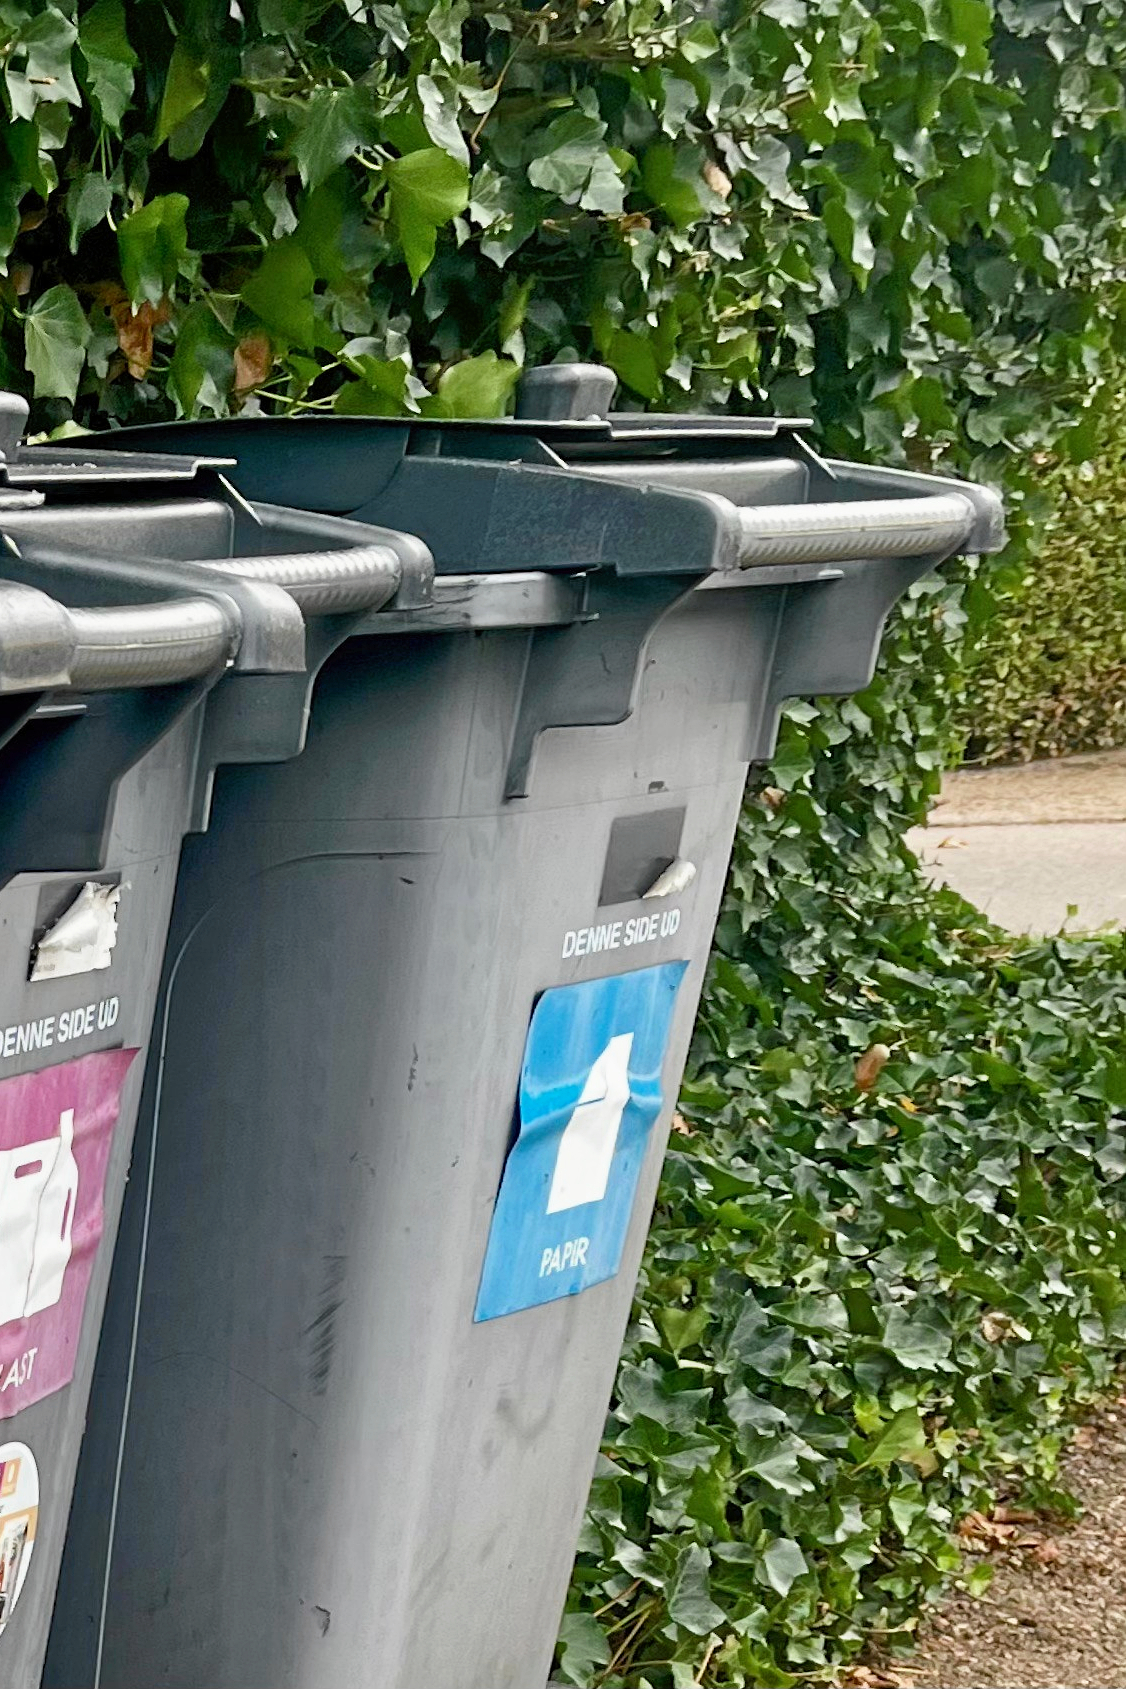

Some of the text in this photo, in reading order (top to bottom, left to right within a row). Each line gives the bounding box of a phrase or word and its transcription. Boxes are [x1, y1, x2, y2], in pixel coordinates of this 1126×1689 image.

[563, 909, 681, 958] DENNE SIDE UD
[57, 1005, 95, 1043] SIDE
[97, 997, 119, 1030] UD
[538, 1236, 590, 1278] PAPIR
